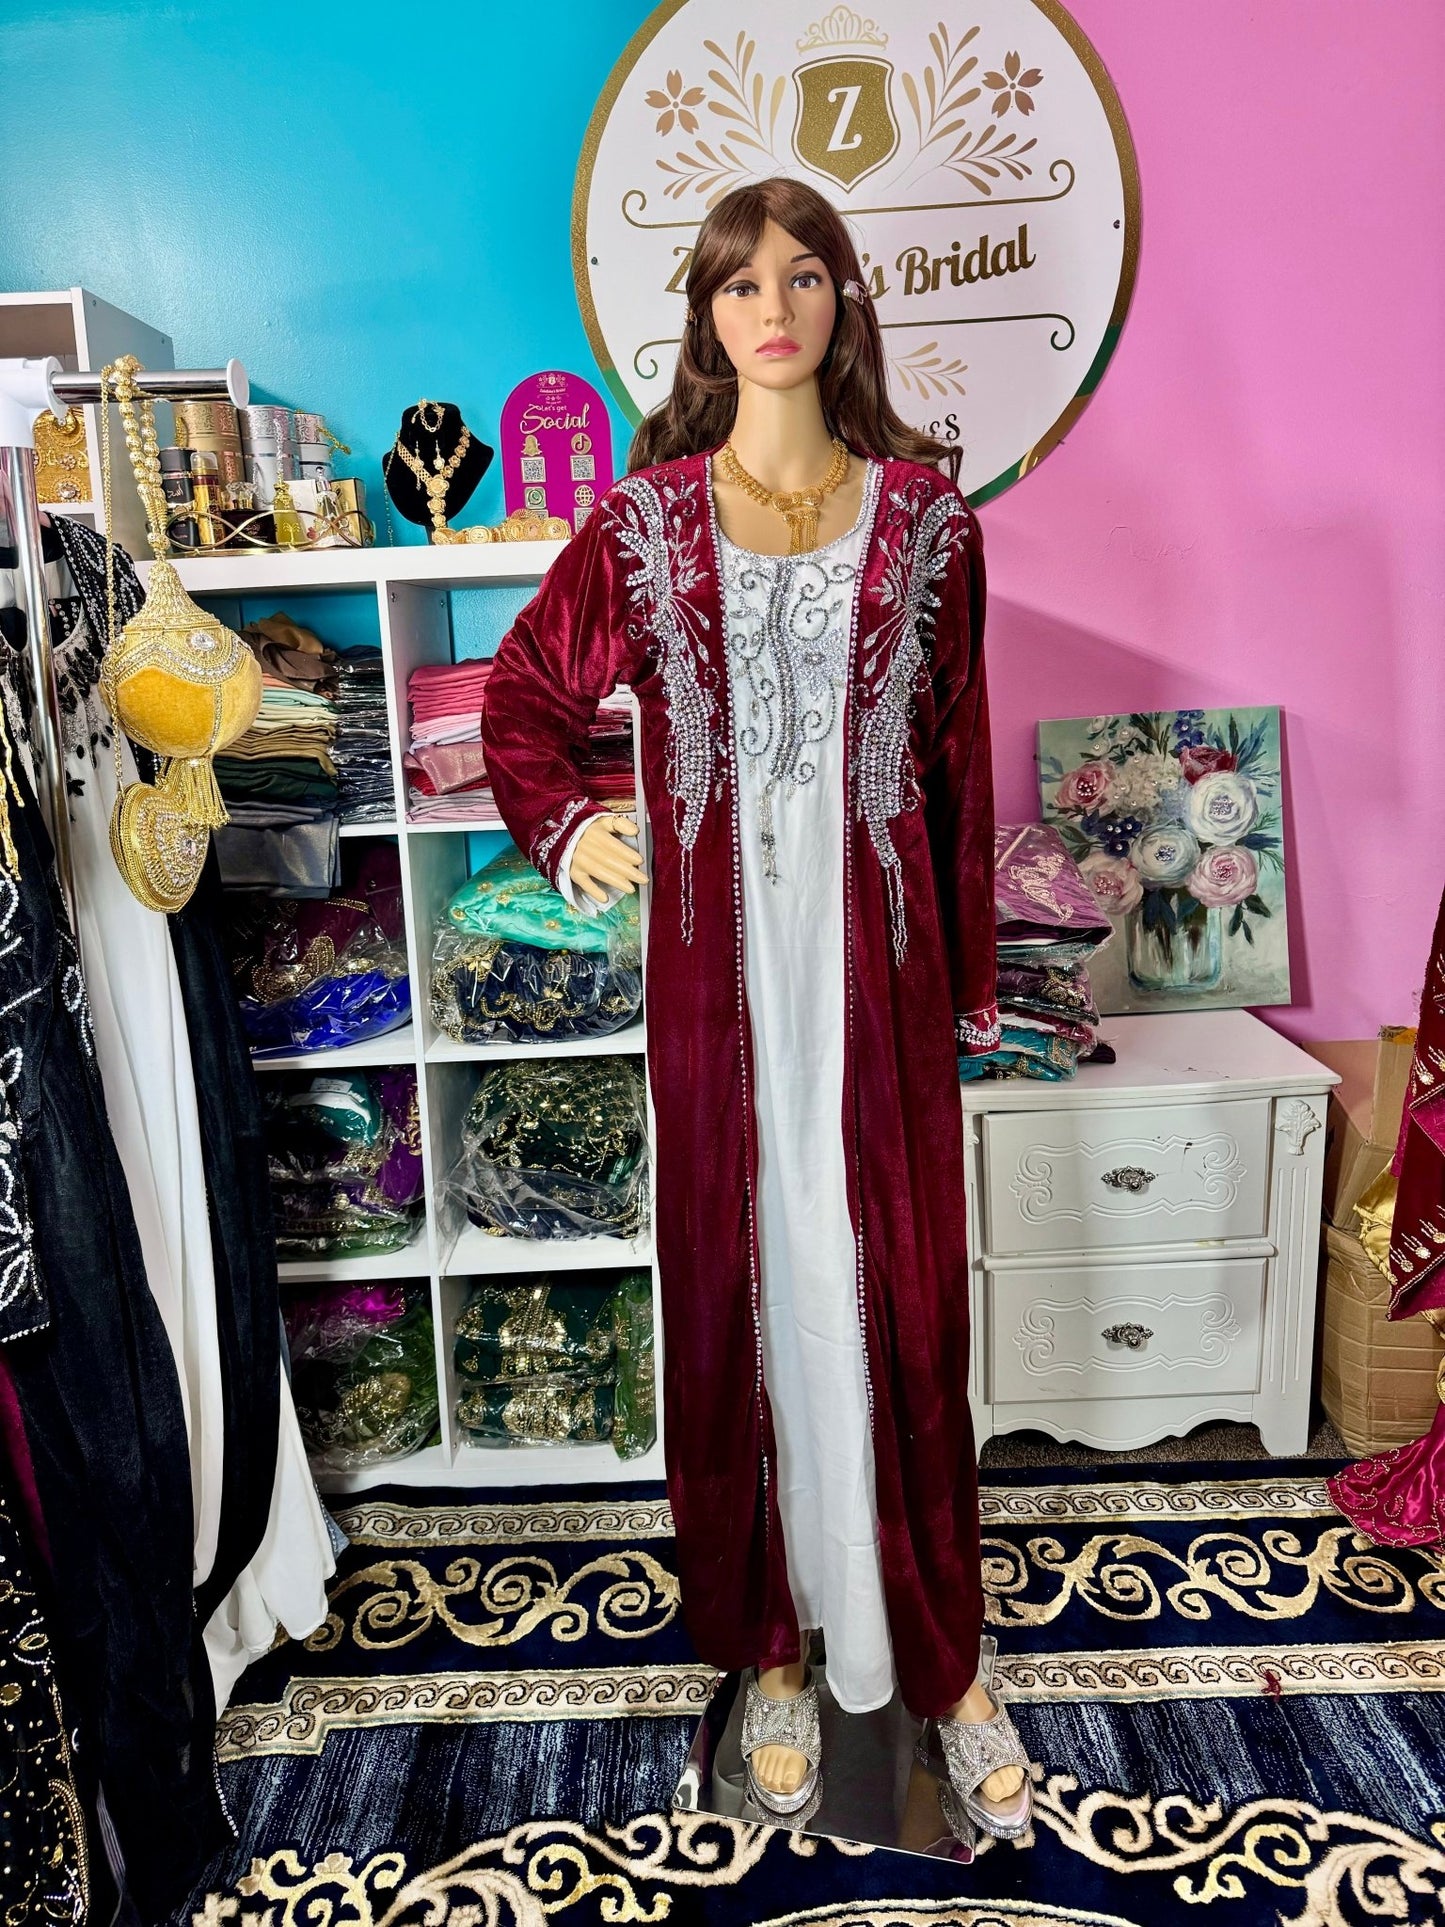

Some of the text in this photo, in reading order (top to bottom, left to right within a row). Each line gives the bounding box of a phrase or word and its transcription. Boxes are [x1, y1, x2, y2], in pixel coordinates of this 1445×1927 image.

[826, 85, 862, 152] Z
[895, 223, 1036, 295] Bridal
[519, 403, 590, 435] Social
